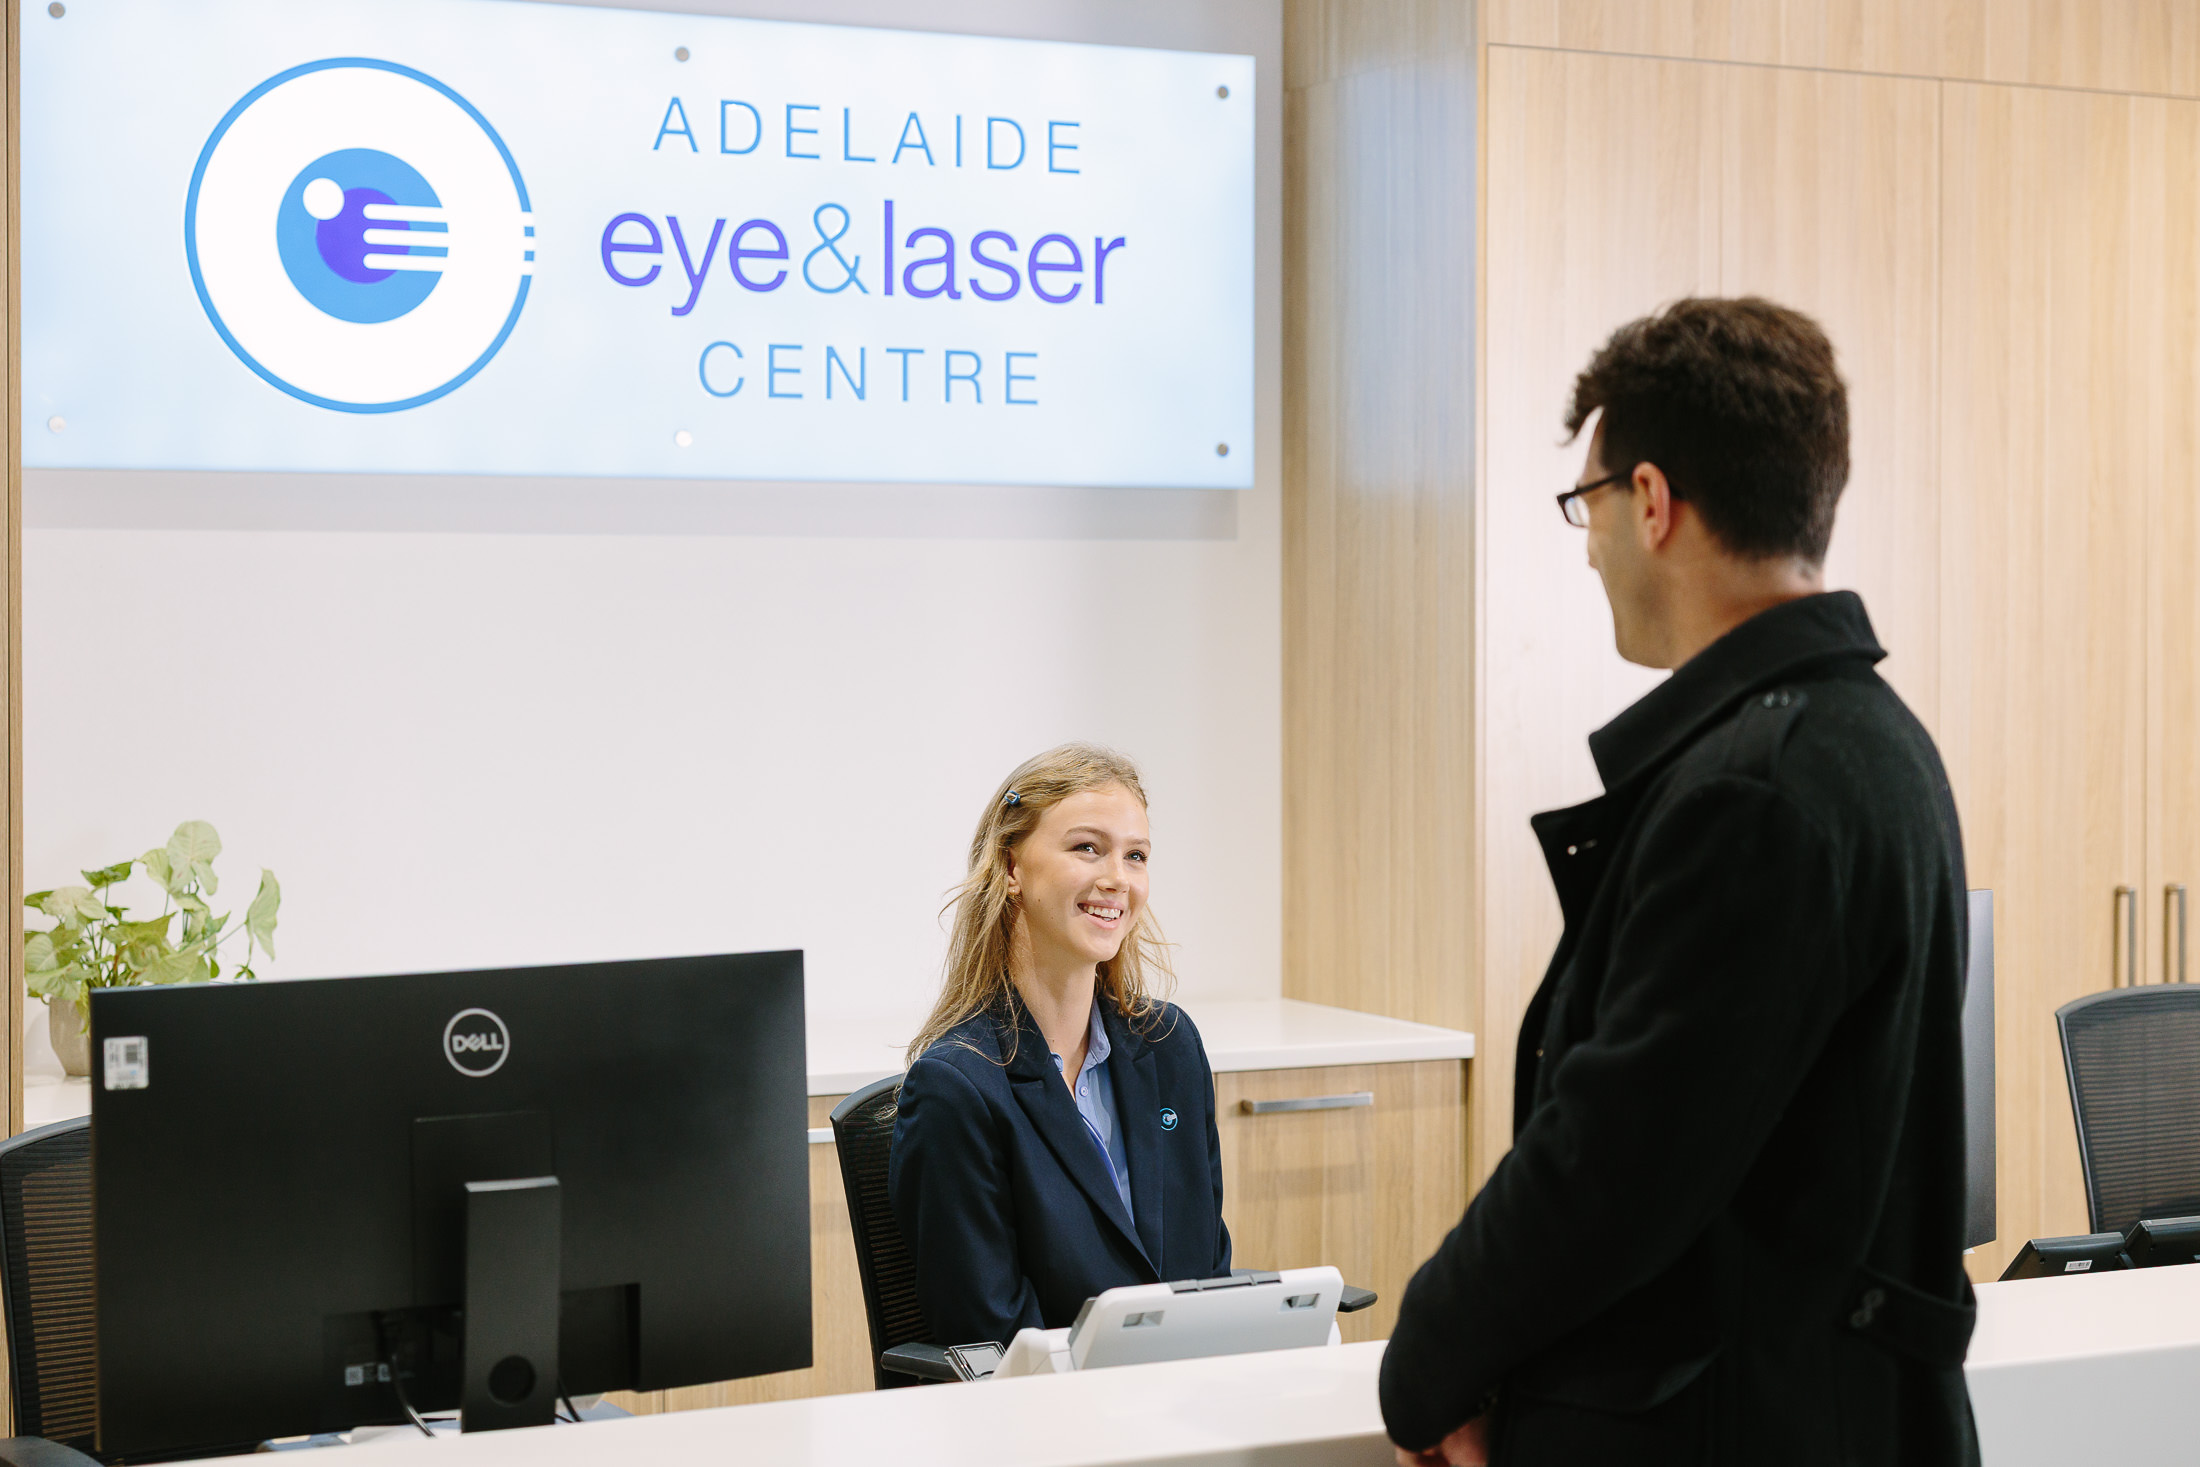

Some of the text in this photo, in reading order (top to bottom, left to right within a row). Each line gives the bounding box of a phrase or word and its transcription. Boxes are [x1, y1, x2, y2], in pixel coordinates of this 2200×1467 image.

[653, 97, 1081, 174] ADELAIDE
[699, 341, 1039, 405] CENTRE
[452, 1032, 503, 1053] DELL
